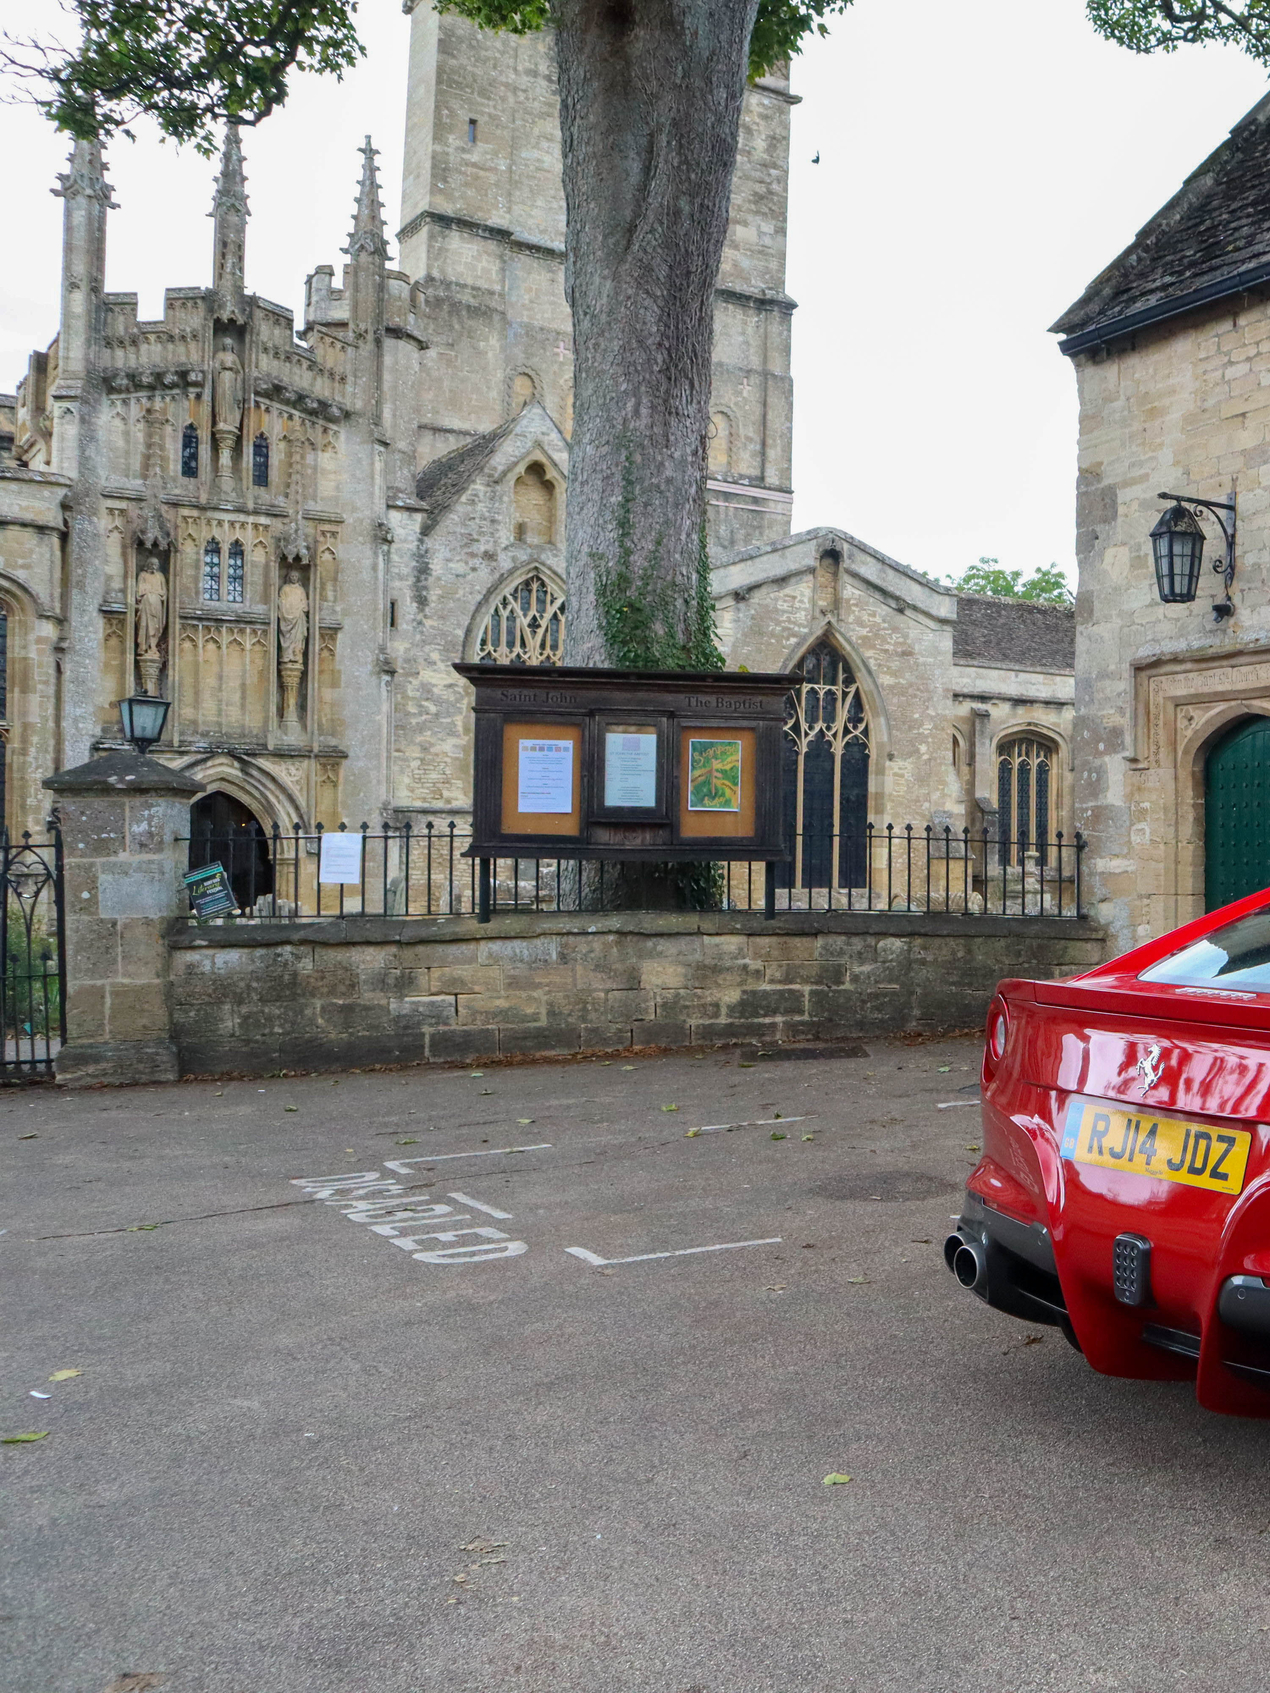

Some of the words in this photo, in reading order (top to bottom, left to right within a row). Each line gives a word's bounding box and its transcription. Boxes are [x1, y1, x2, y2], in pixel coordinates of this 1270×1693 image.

[501, 690, 537, 702] Saint
[543, 692, 577, 704] John
[685, 696, 711, 708] The
[715, 697, 764, 711] Baptist
[1064, 1137, 1075, 1149] GB
[1088, 1113, 1158, 1166] RJ14
[1167, 1129, 1236, 1181] JDZ
[289, 1171, 529, 1264] DISABLED
